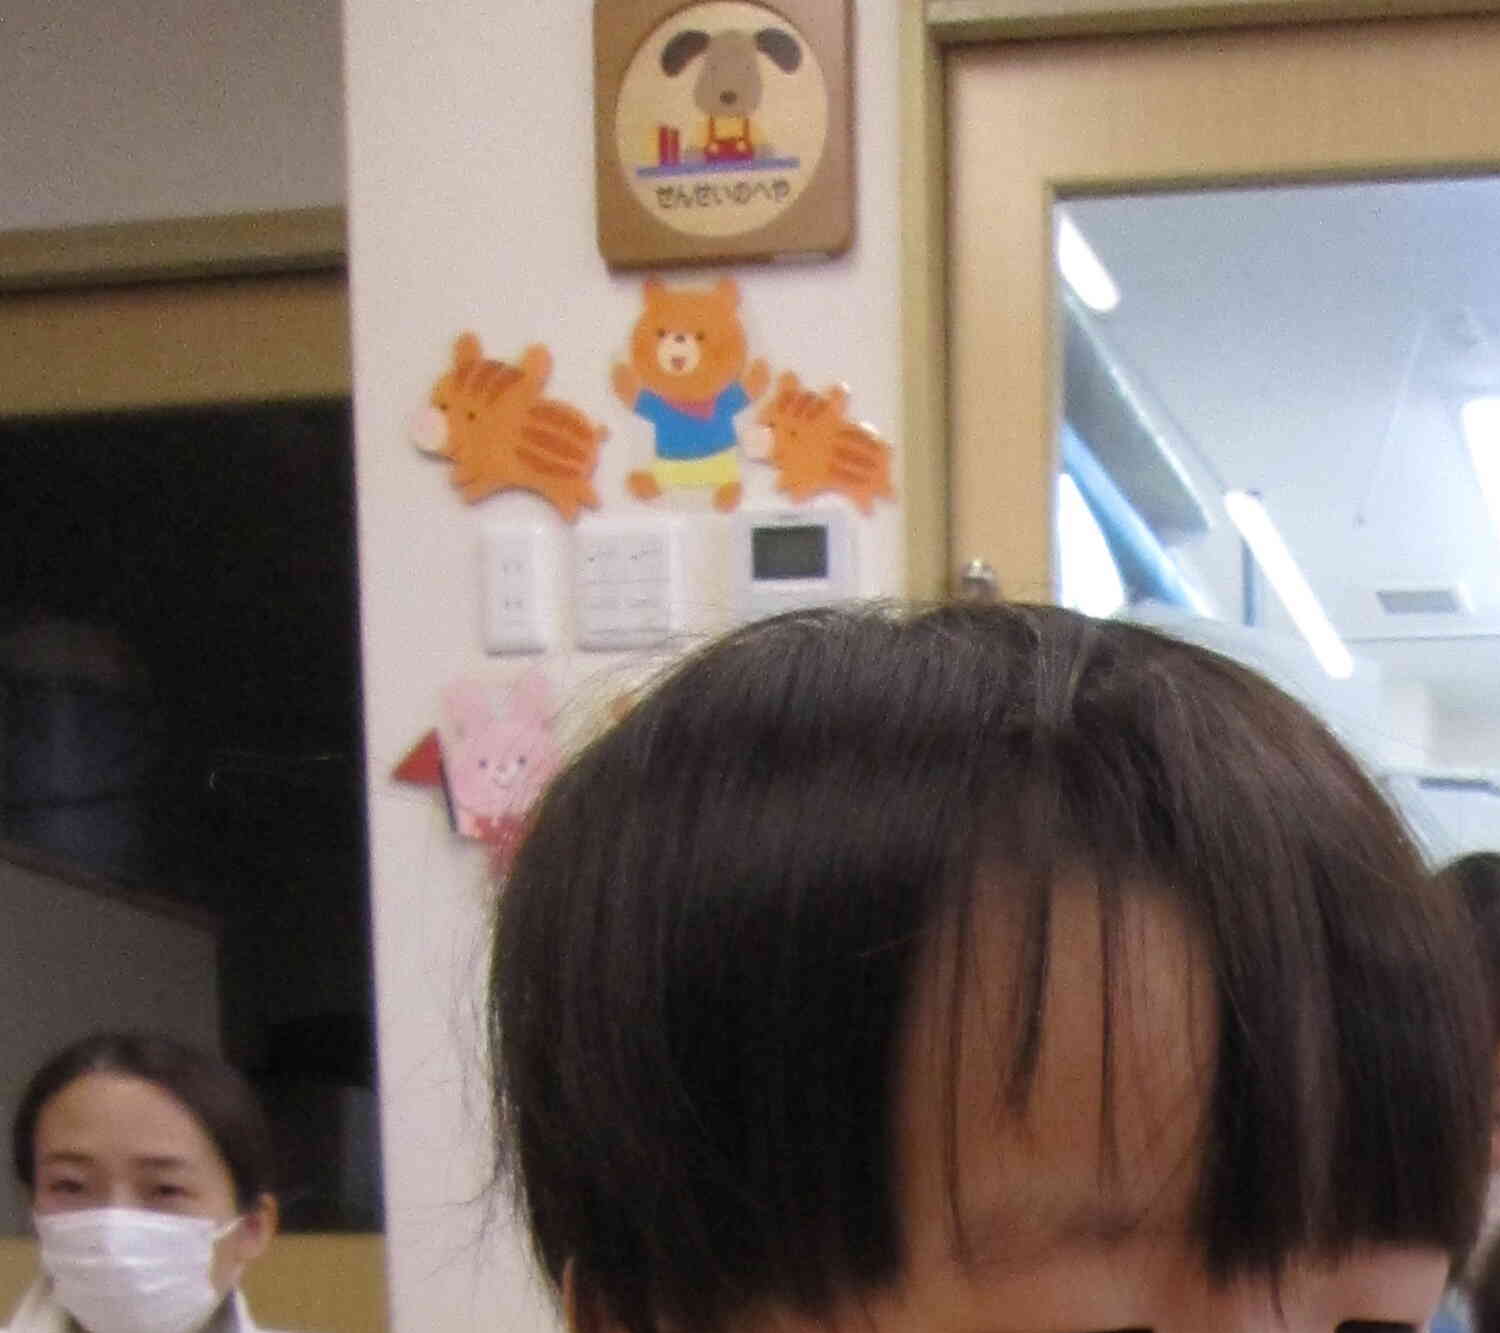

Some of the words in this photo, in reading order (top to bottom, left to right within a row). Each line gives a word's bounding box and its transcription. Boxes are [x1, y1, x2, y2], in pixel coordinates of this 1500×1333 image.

[655, 179, 791, 208] せんせいのへや
